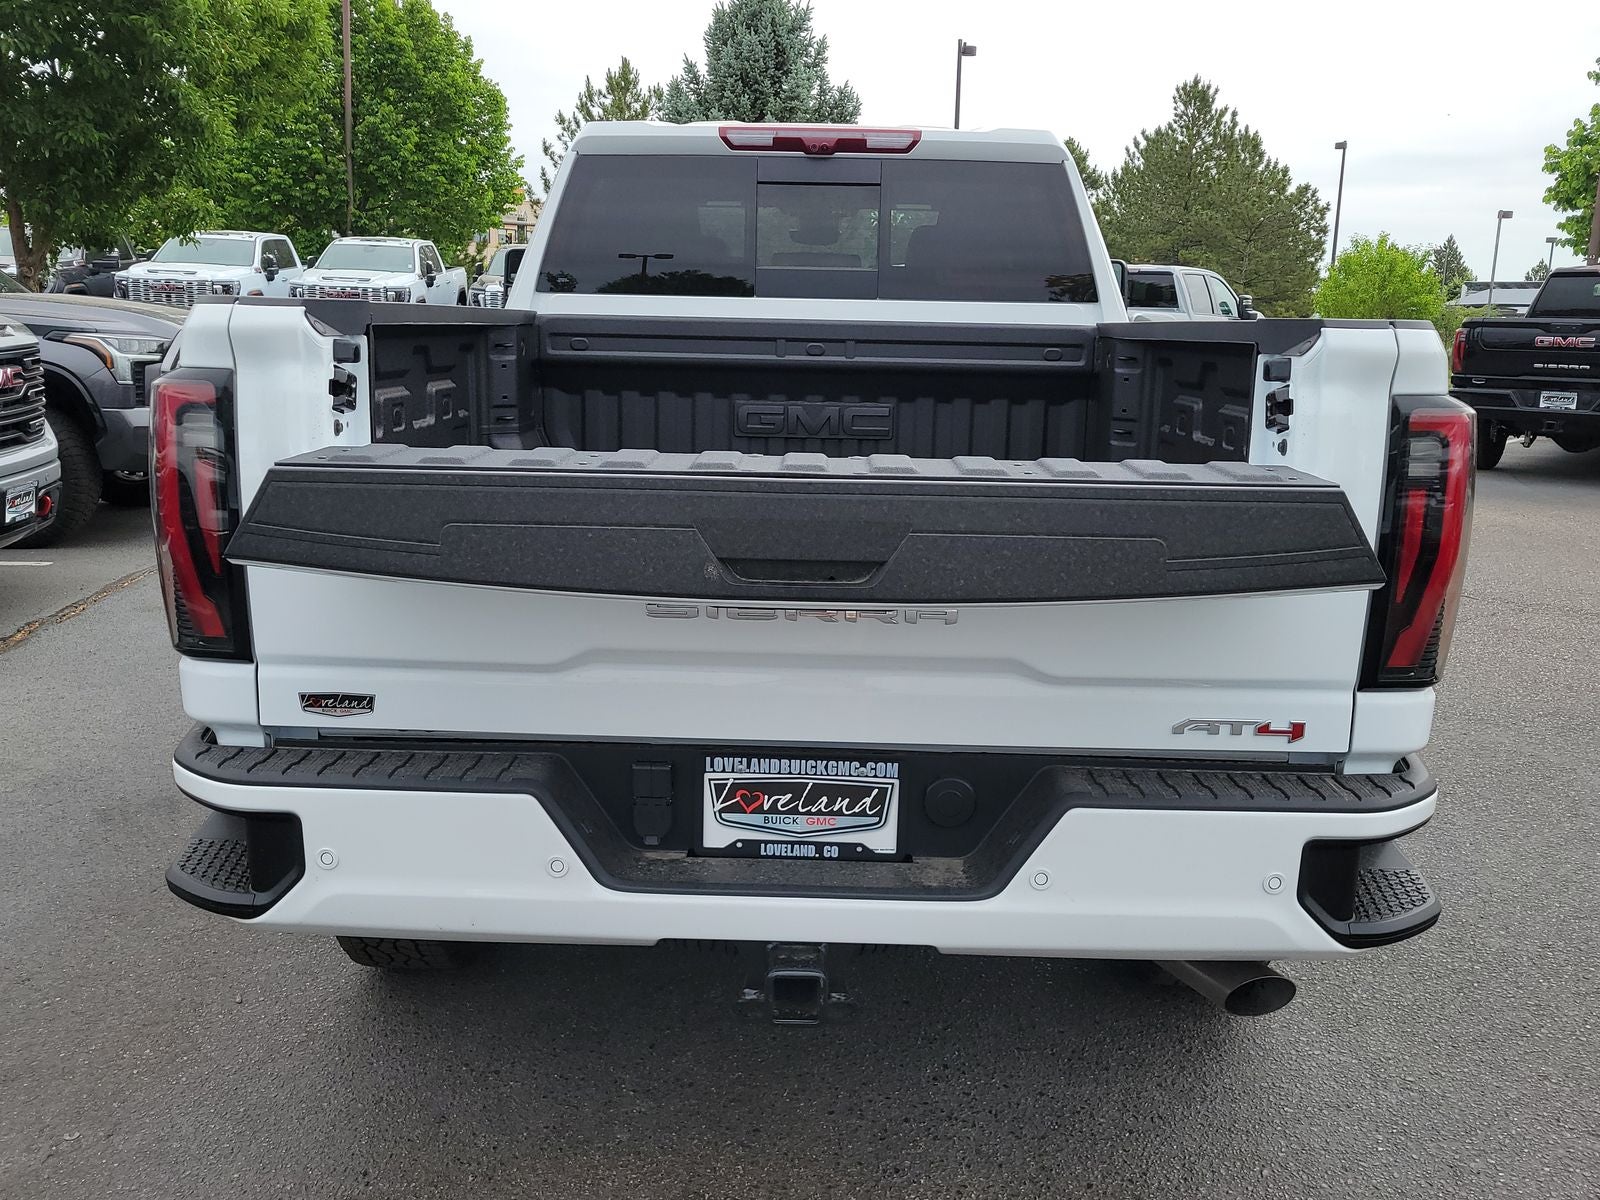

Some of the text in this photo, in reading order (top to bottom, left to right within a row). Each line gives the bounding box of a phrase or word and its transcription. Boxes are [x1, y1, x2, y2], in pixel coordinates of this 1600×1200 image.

[1535, 336, 1596, 348] GMC
[0, 367, 24, 388] MC
[737, 405, 890, 436] GMC
[302, 693, 371, 708] Loveland
[1172, 718, 1306, 743] AT4
[705, 756, 899, 778] LOVELANDBUICKGMC.COM
[713, 778, 881, 815] Loveland
[763, 815, 837, 826] BUICK GMC
[823, 845, 839, 857] CO
